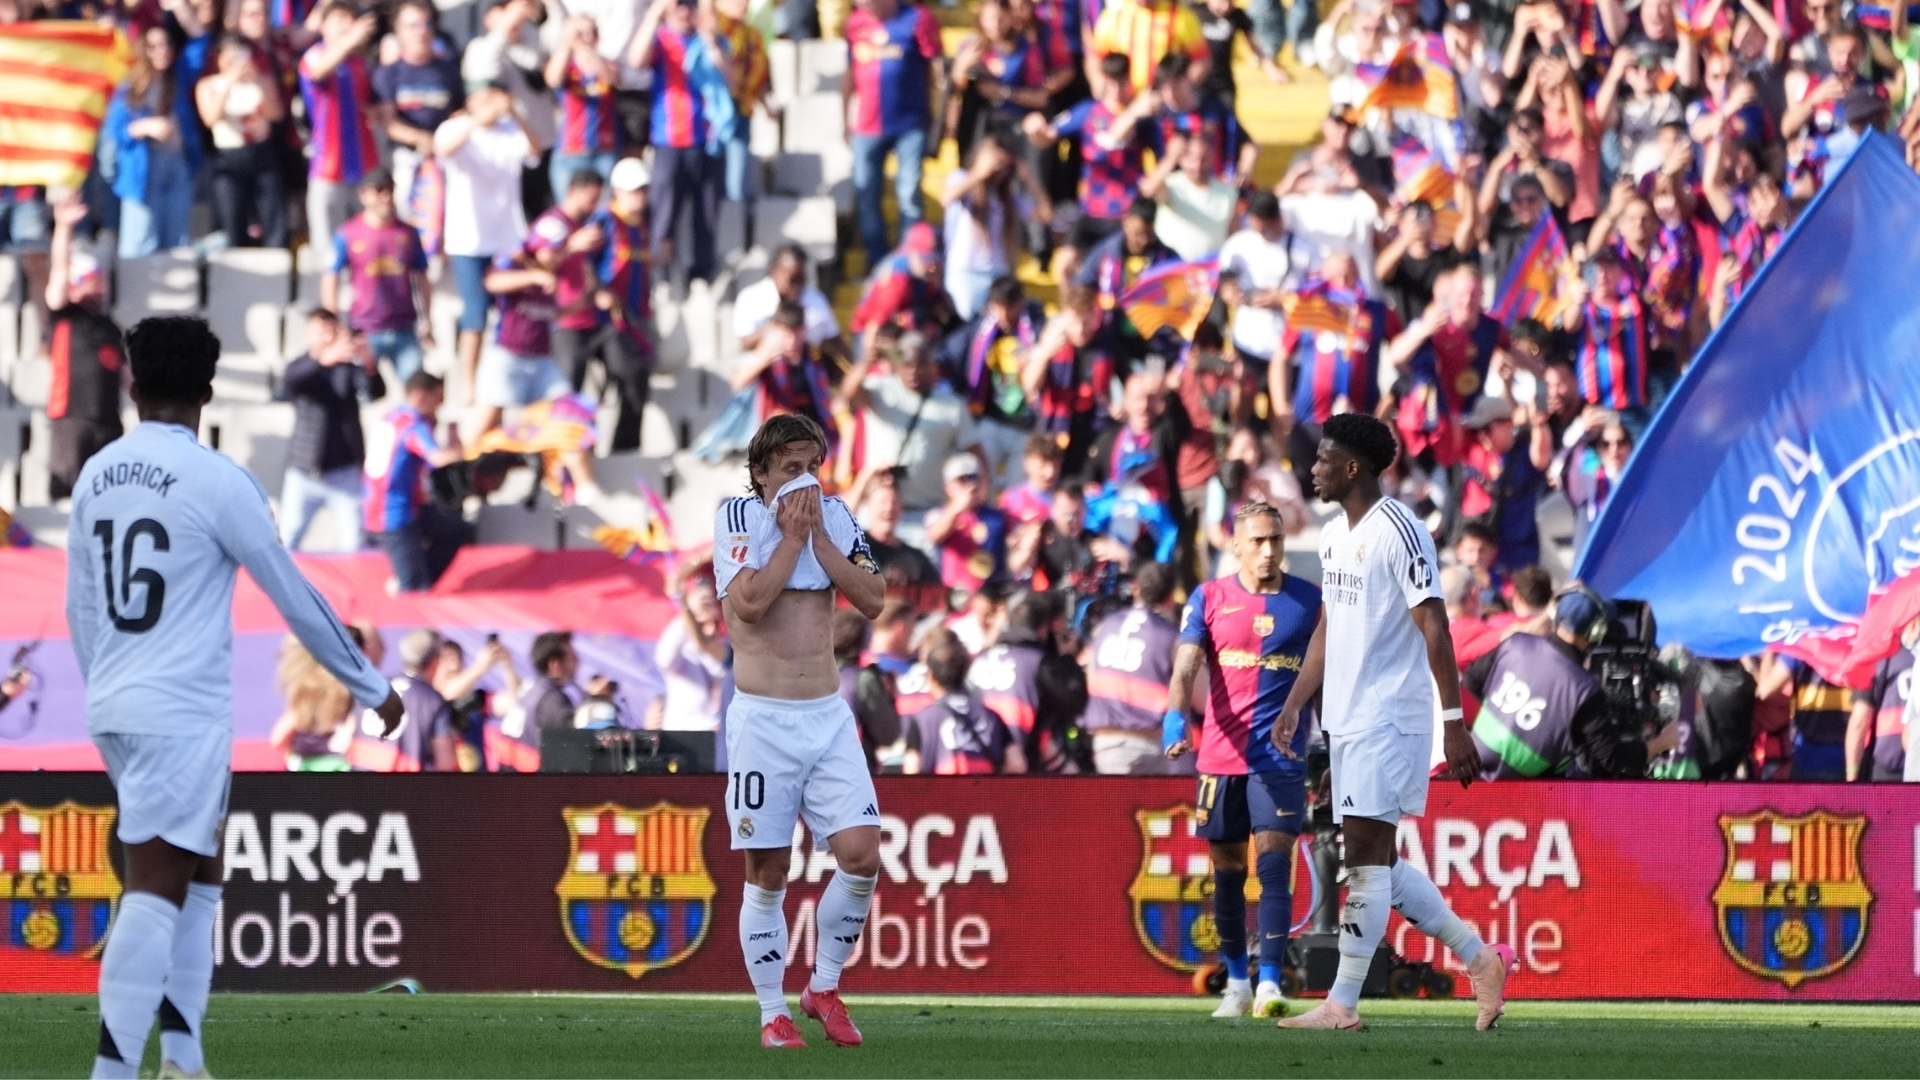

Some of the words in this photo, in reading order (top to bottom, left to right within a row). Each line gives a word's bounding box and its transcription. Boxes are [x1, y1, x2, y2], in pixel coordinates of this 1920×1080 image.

[92, 462, 178, 498] ENDRICK
[1732, 437, 1823, 585] 2024
[92, 517, 171, 635] 16
[1490, 670, 1548, 731] 196
[733, 770, 765, 810] 10
[222, 812, 420, 896] ARÇA
[1336, 818, 1581, 902] ARÇA
[214, 892, 402, 967] obile
[785, 894, 990, 969] Mbile
